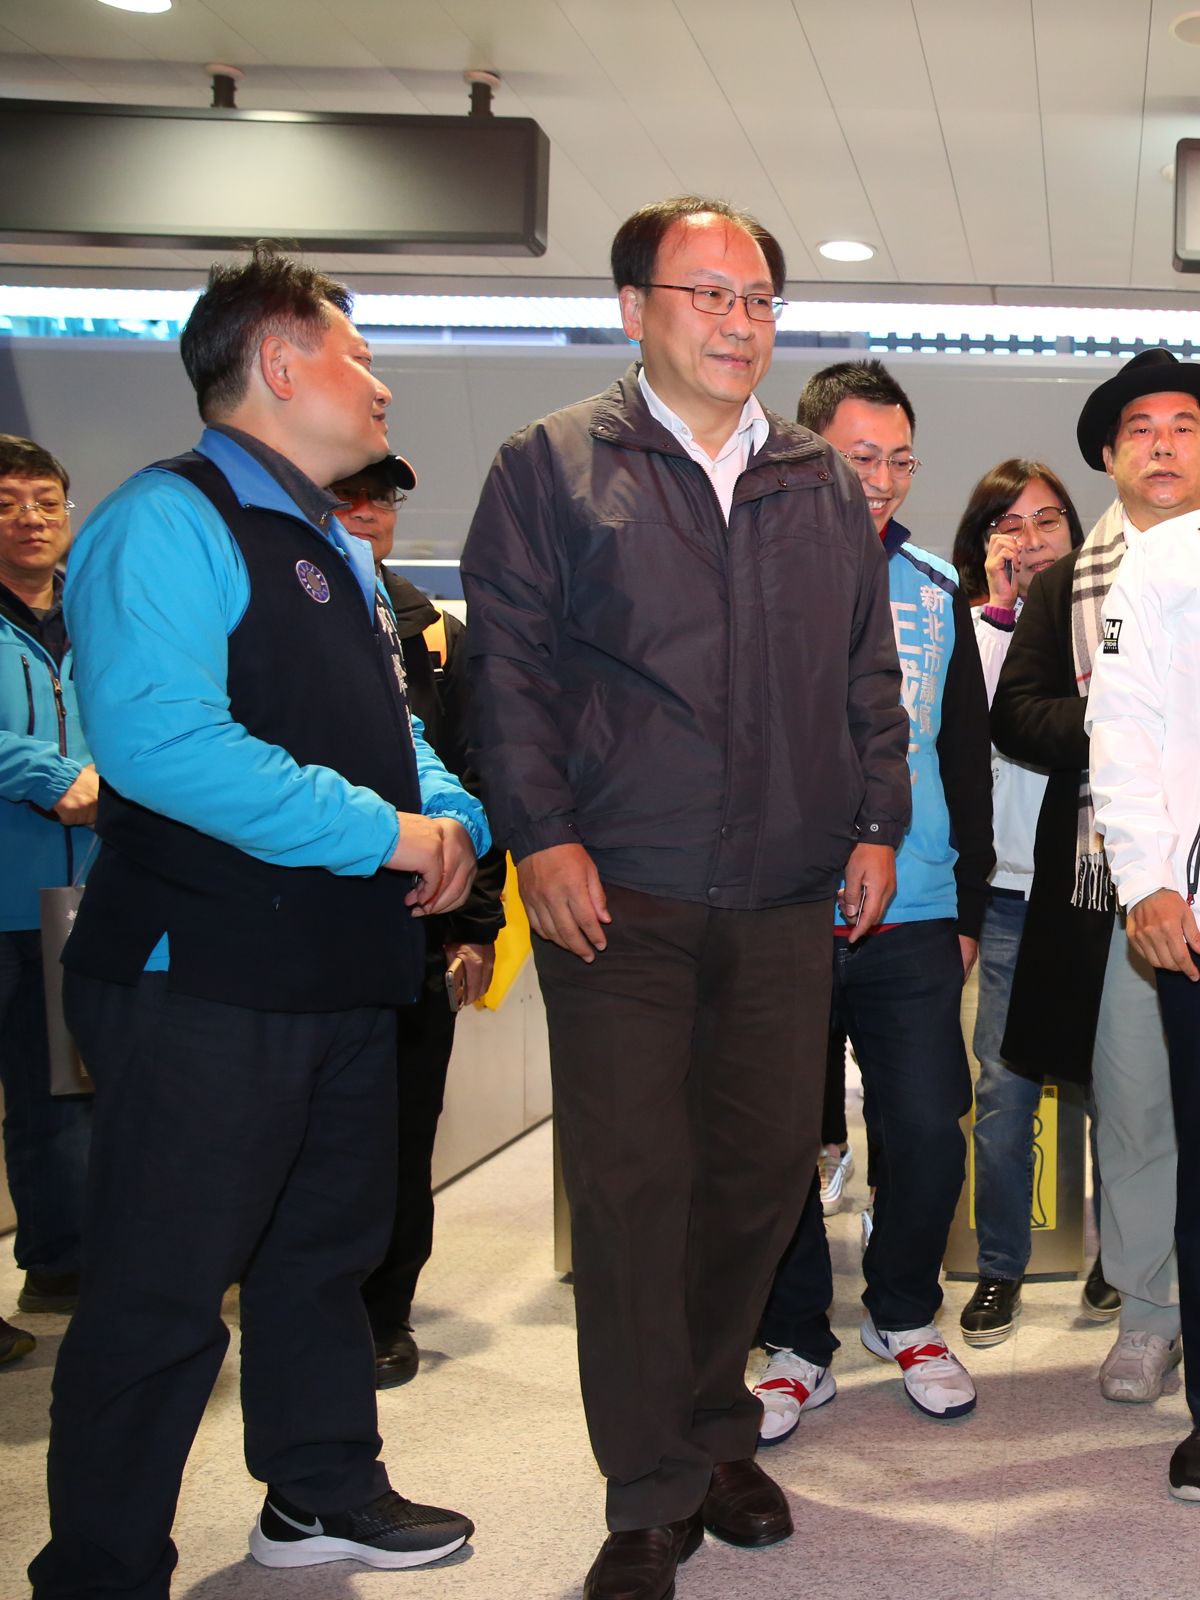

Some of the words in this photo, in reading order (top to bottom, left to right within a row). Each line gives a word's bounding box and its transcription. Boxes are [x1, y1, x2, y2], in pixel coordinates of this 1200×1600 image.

[919, 584, 945, 737] 新北市議員
